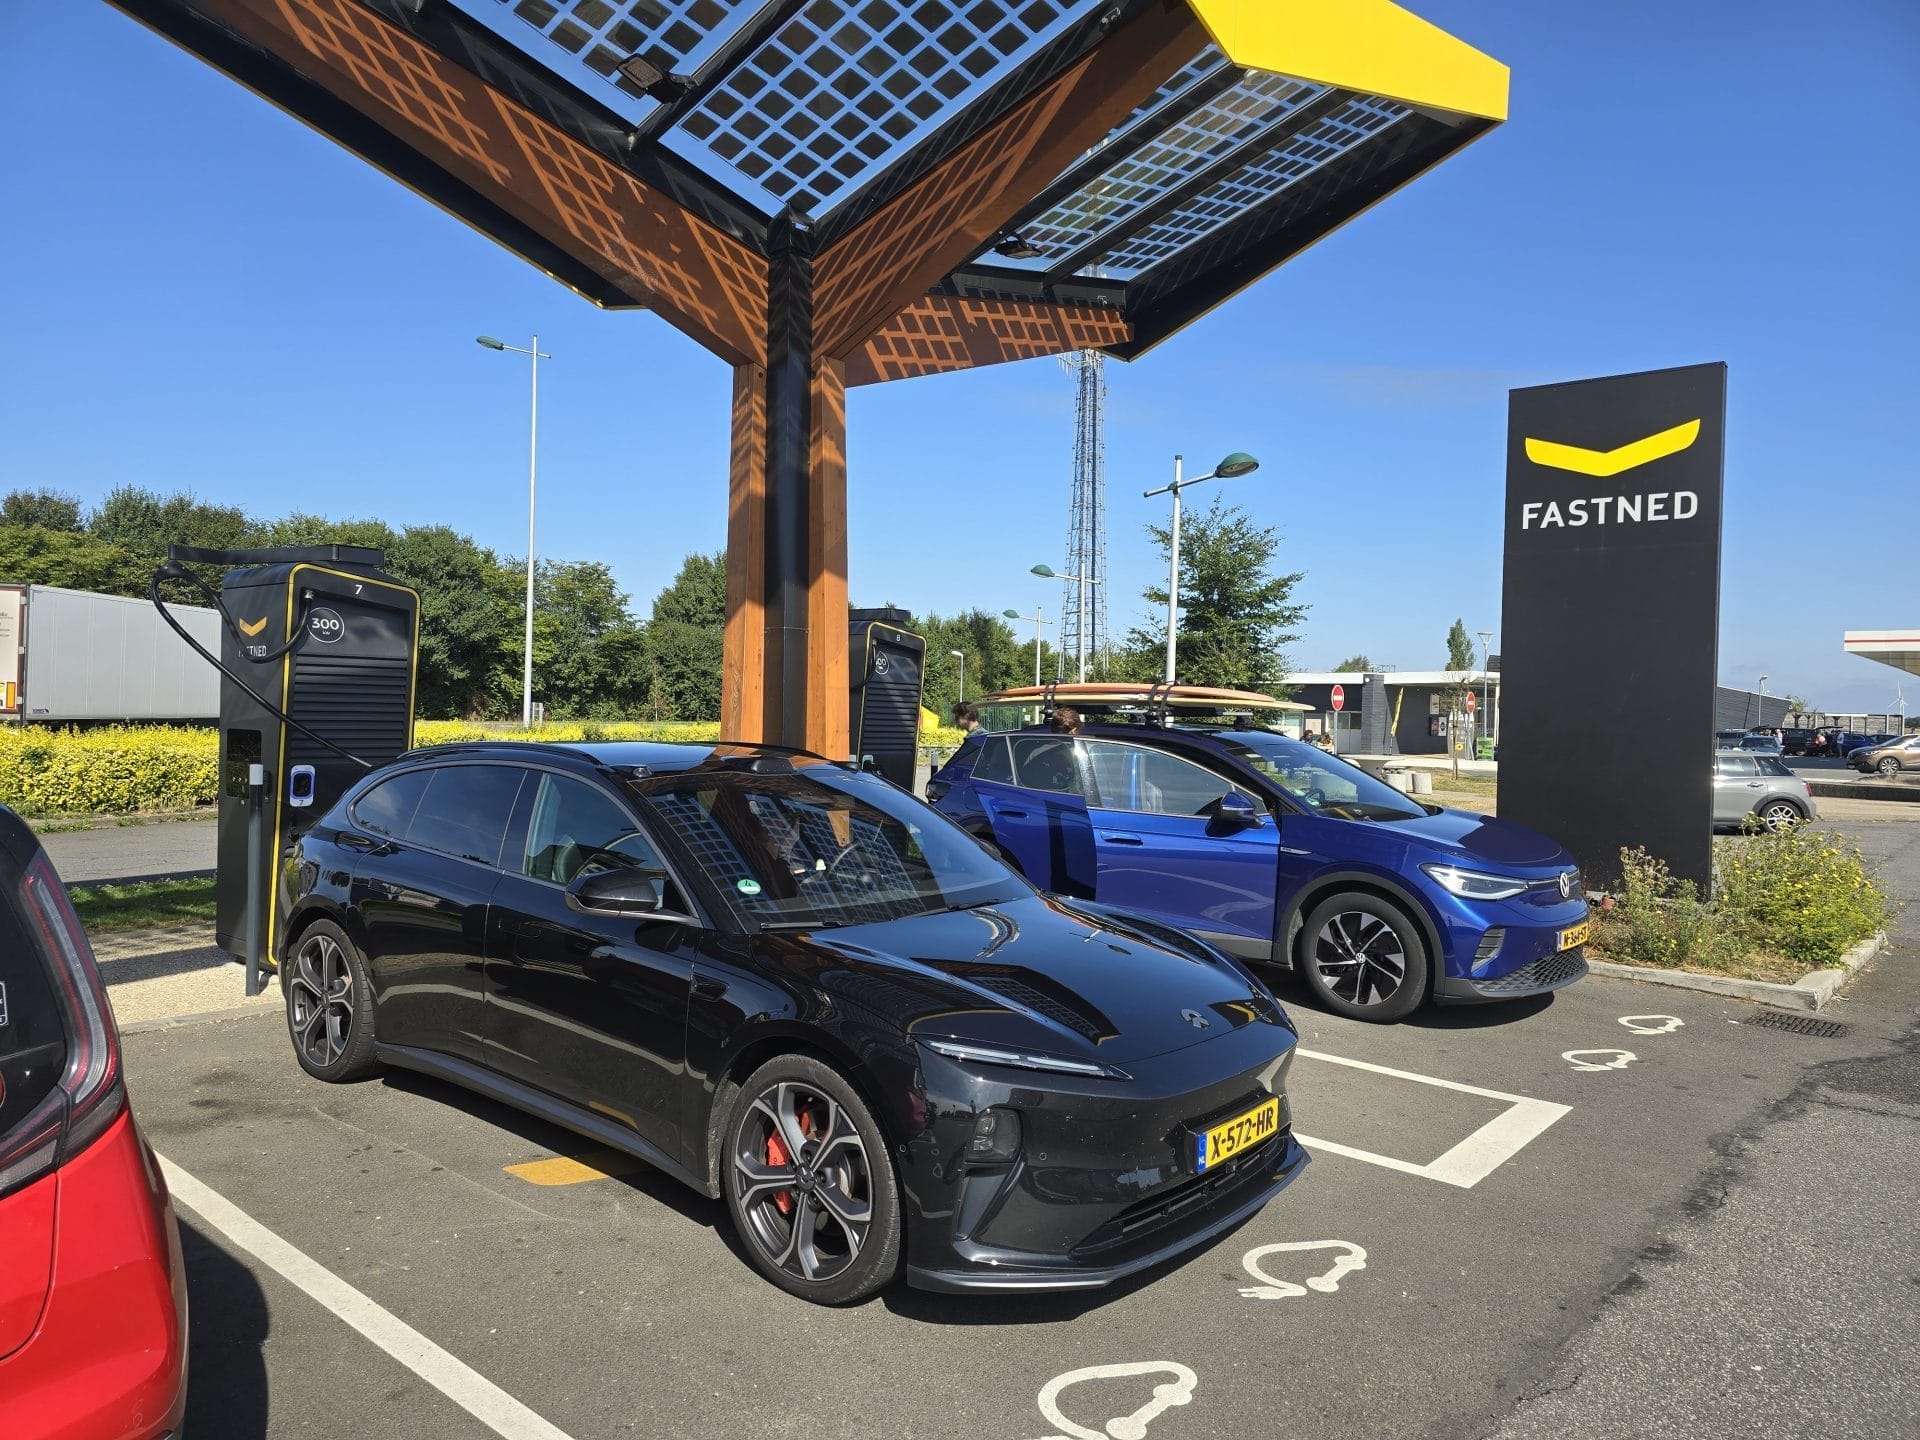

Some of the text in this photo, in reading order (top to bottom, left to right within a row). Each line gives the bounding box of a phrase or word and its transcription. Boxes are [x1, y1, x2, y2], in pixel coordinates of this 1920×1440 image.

[1521, 490, 1699, 530] FASTNED
[355, 584, 363, 595] 7
[311, 617, 340, 630] 300
[1210, 1106, 1274, 1161] X-572-HR
[1198, 1155, 1205, 1166] NL
